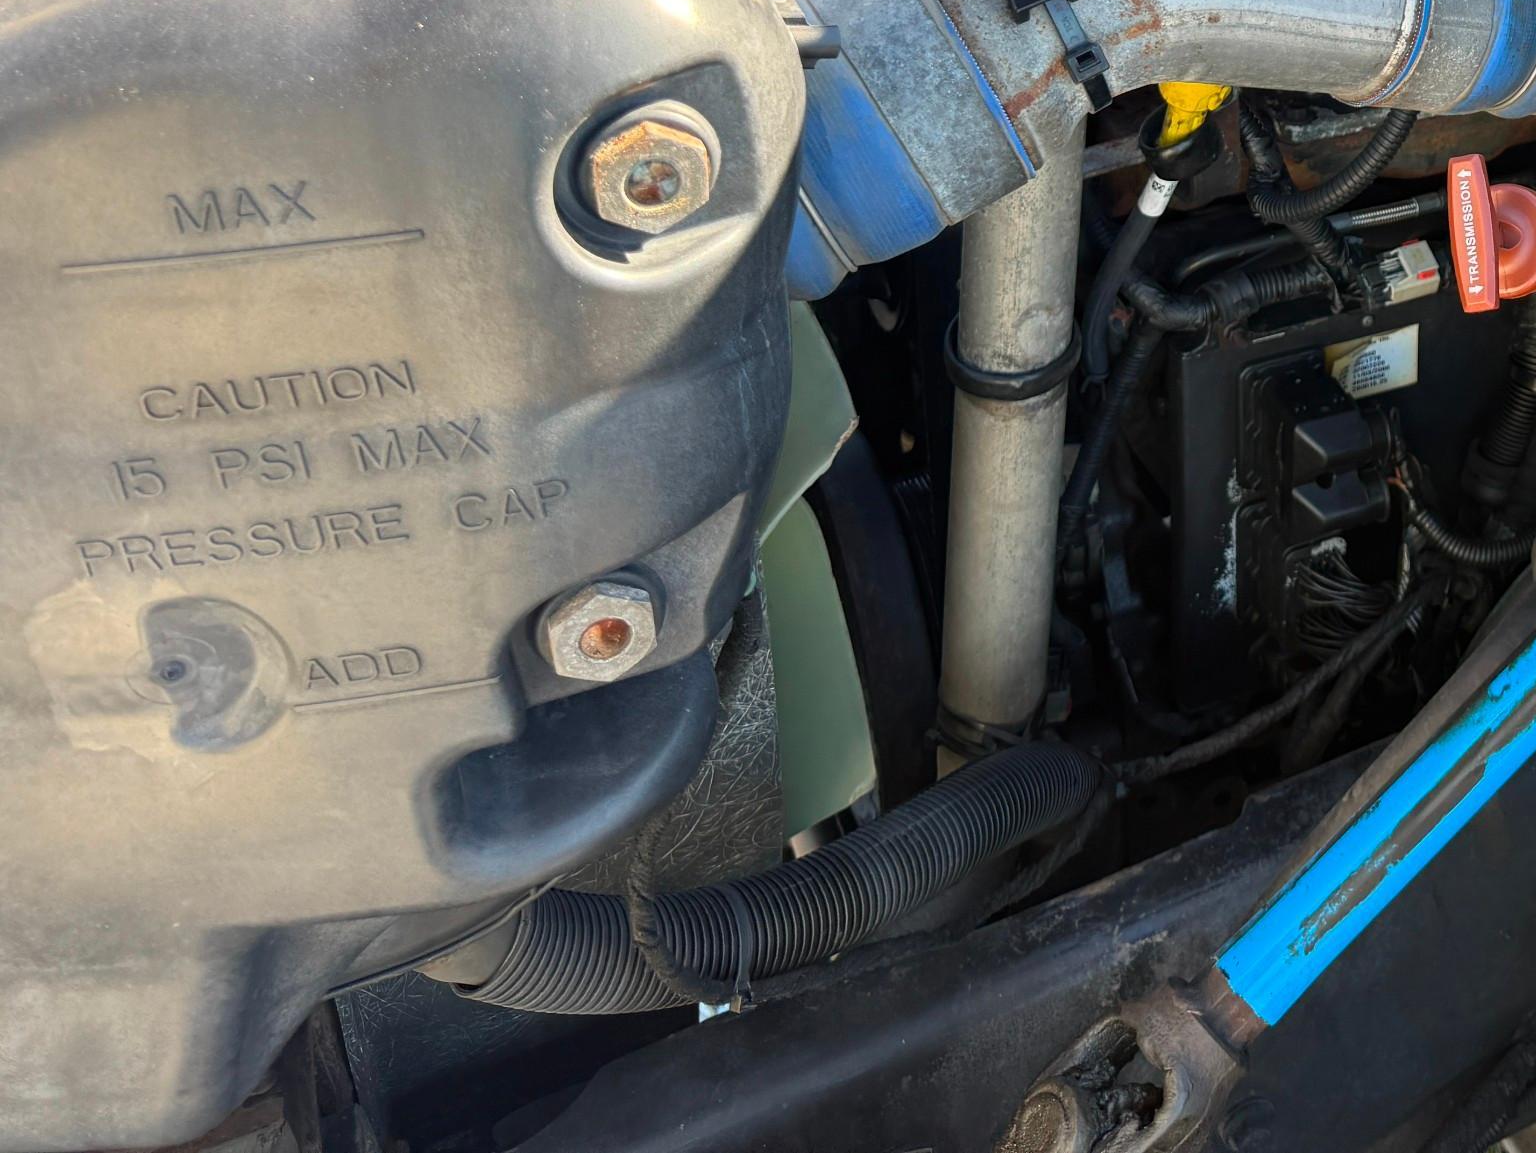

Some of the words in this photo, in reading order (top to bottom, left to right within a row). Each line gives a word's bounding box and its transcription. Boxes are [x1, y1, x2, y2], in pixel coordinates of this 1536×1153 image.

[167, 181, 317, 236] MAX
[1459, 180, 1480, 284] TRANSMISSION
[139, 360, 417, 422] CAUTION
[110, 457, 168, 502] 15
[210, 441, 312, 489] PSI
[351, 417, 491, 473] MAX
[76, 505, 410, 578] PRESSURE
[454, 478, 570, 532] CAP
[304, 645, 424, 691] ADD
